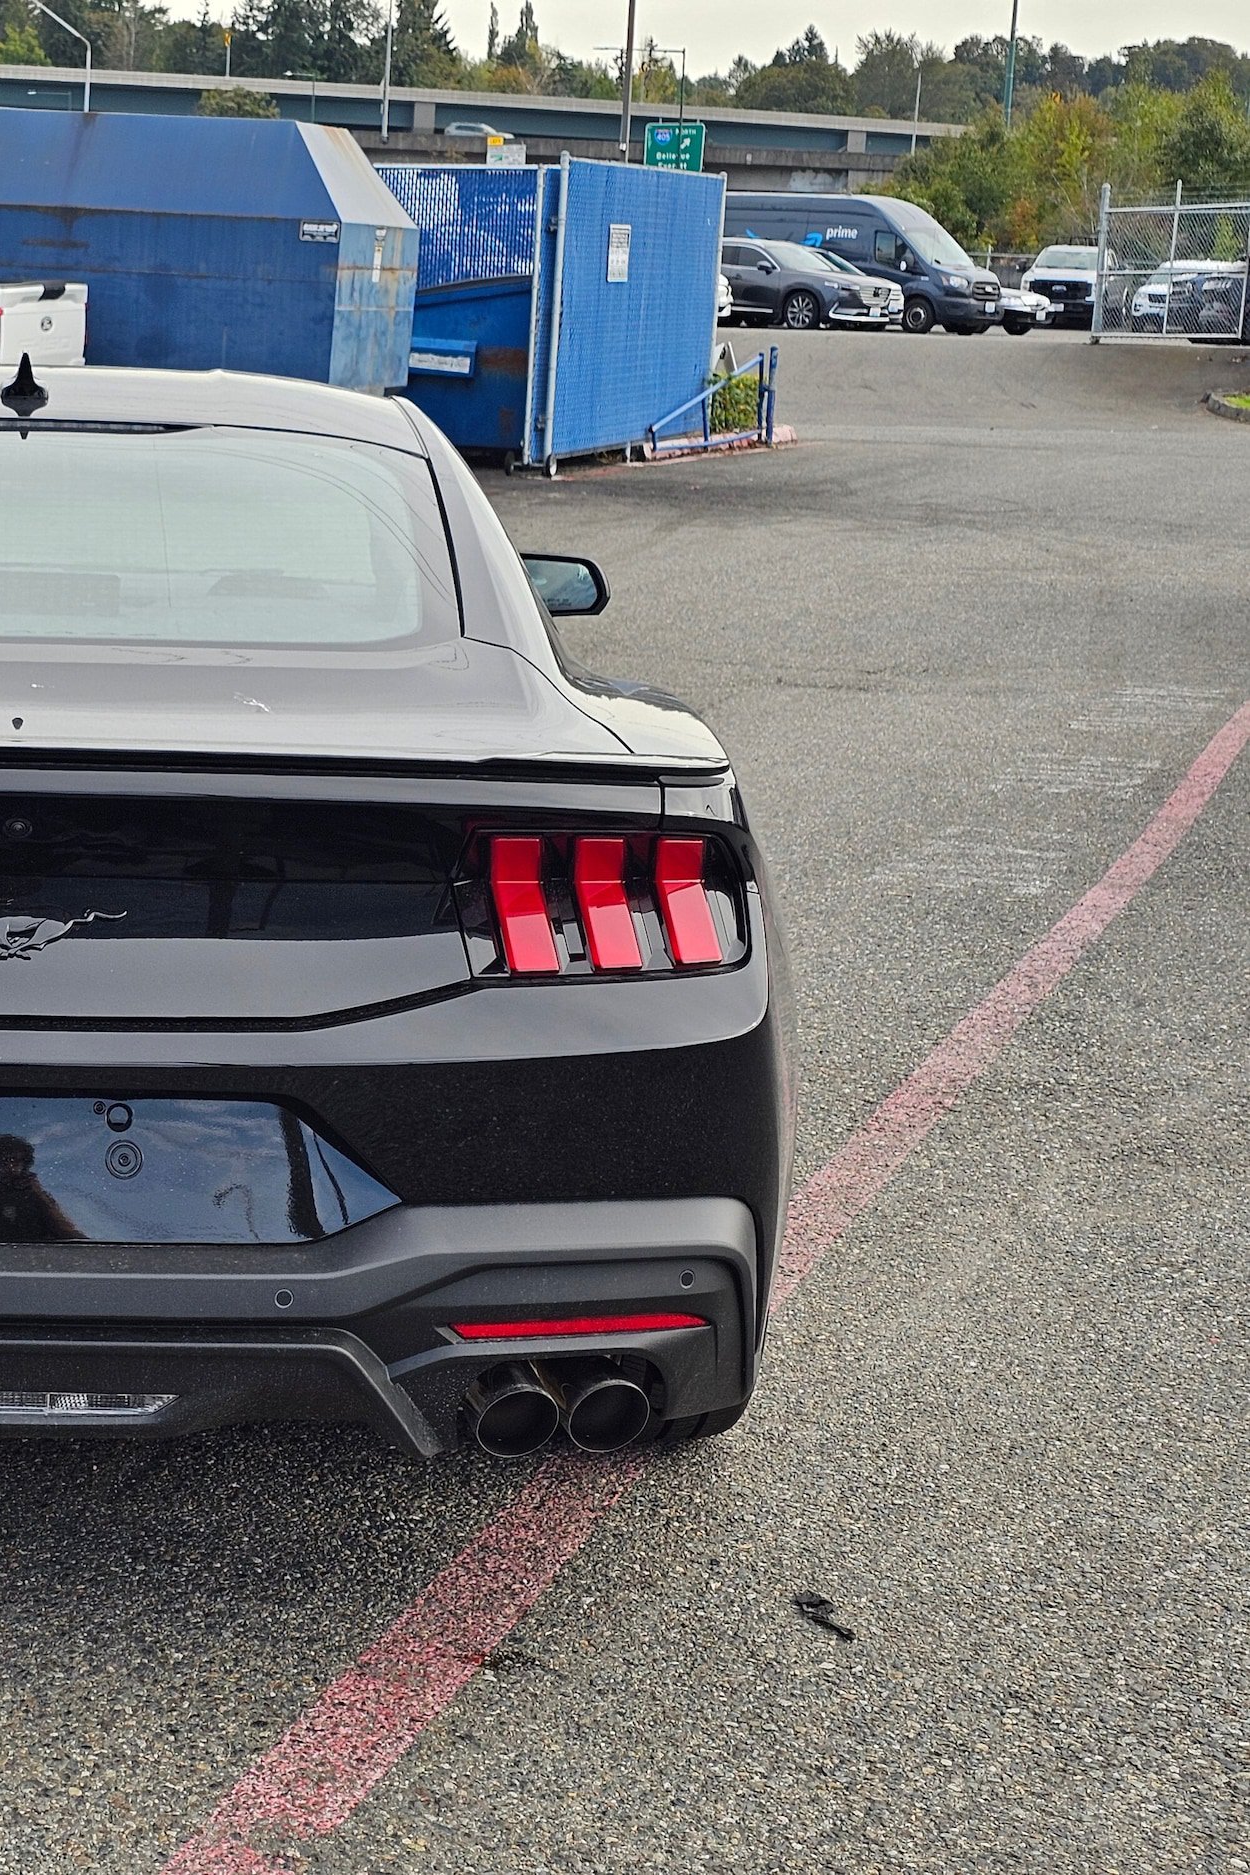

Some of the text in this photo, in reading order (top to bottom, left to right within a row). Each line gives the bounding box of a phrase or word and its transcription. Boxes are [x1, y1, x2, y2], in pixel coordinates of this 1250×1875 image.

[657, 133, 670, 141] 405
[658, 162, 687, 170] Evertt
[826, 225, 858, 240] prime
